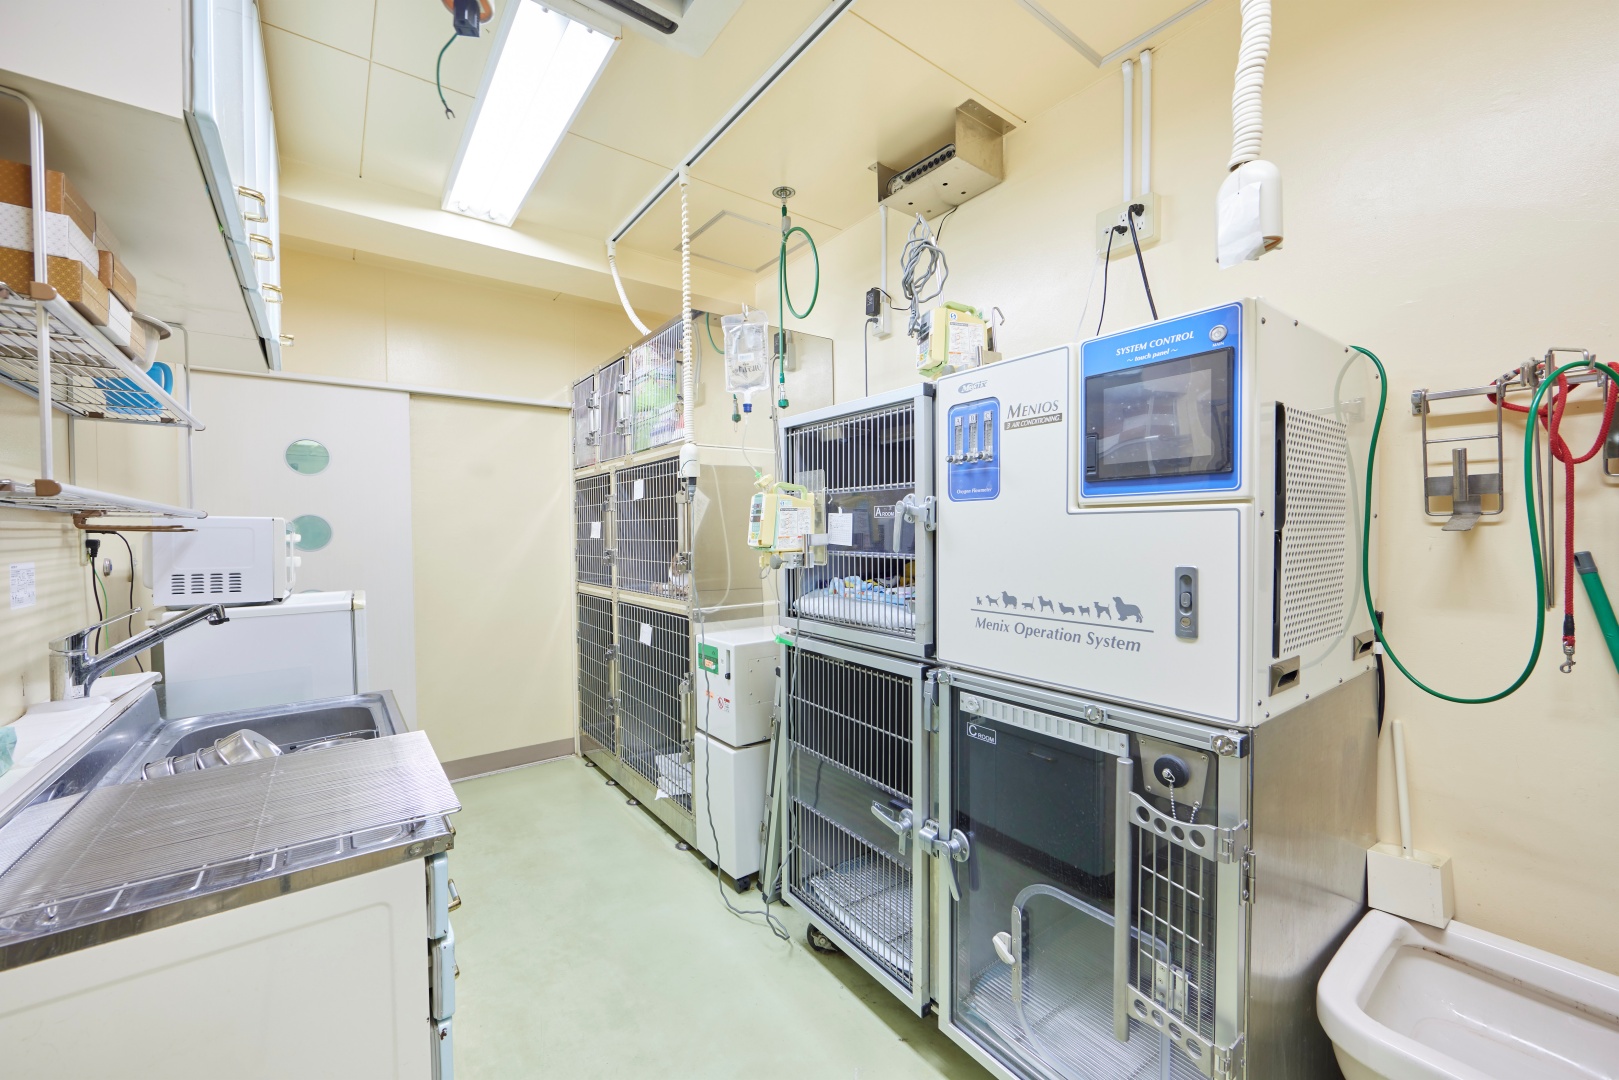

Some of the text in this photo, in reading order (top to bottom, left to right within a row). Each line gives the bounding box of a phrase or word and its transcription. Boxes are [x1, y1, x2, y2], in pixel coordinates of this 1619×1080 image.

[1116, 331, 1195, 356] SYSTEM CONTROL
[1134, 348, 1170, 362] touch panel
[1020, 414, 1061, 427] CONDITIONING
[876, 508, 882, 516] A
[975, 616, 1142, 653] Menix Operation System
[968, 724, 994, 742] C ROOM
